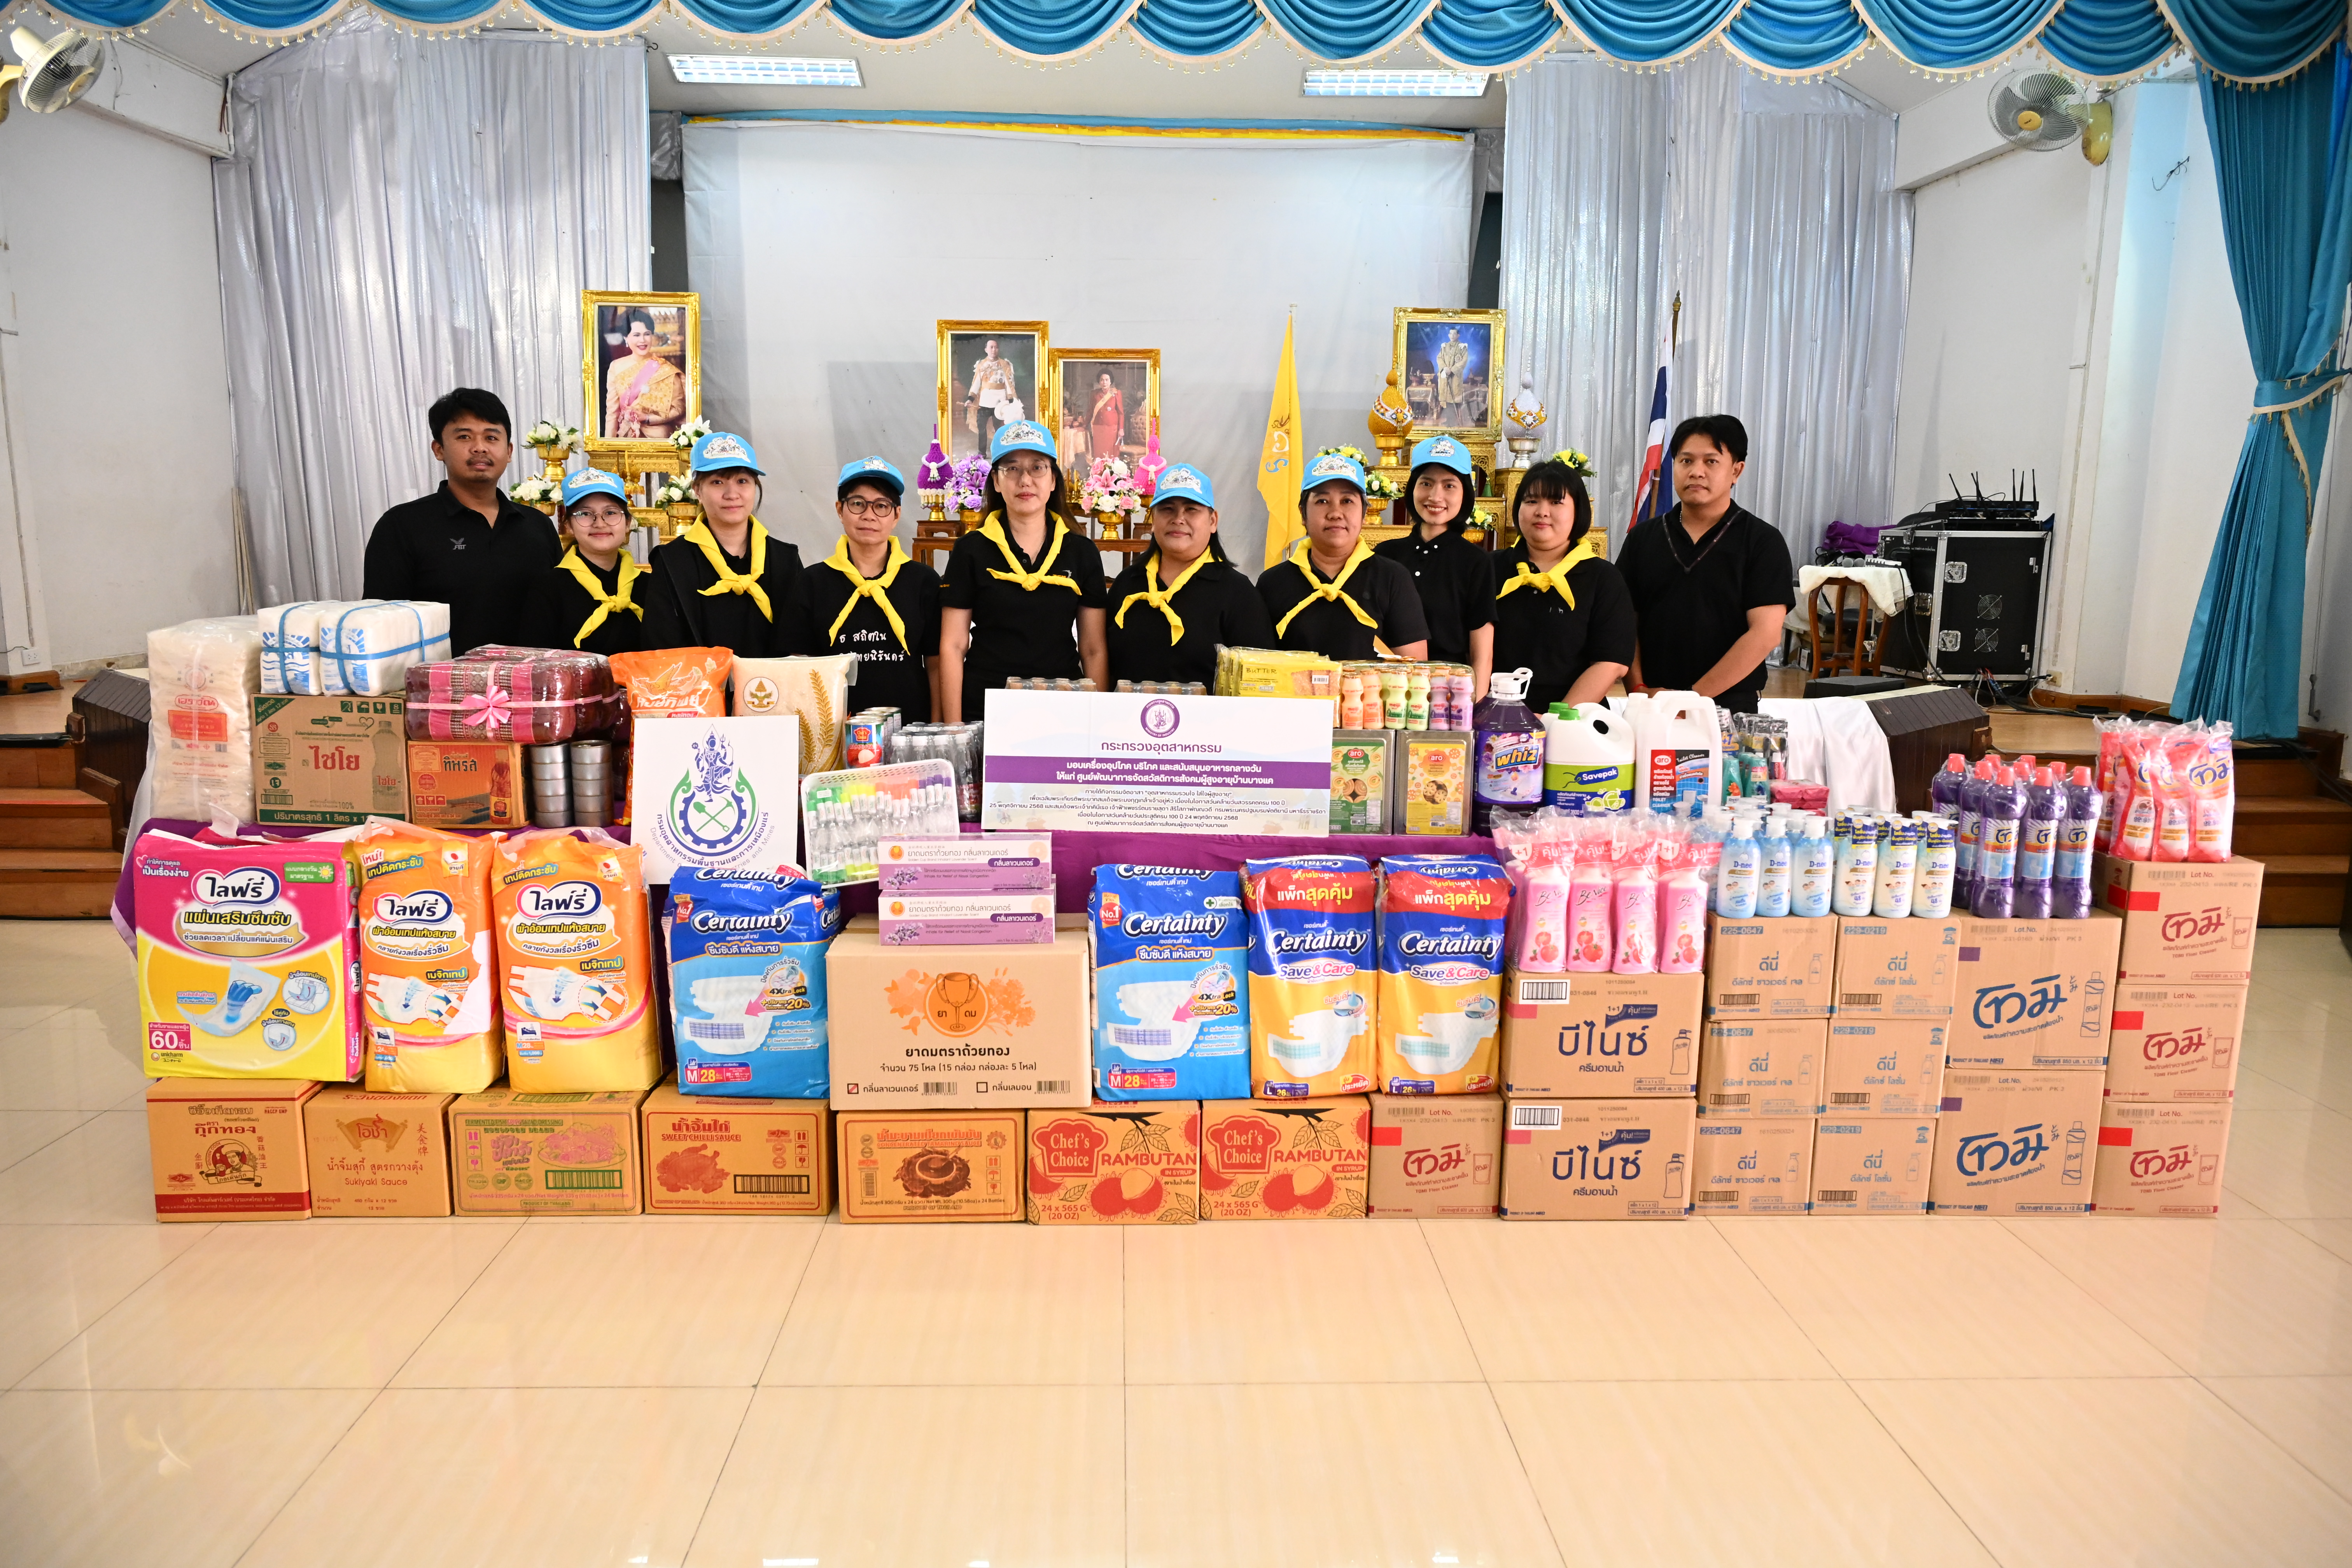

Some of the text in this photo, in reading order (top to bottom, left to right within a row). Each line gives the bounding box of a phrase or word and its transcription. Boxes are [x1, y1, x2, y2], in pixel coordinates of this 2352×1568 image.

[839, 630, 886, 643] ธ สถิตใน
[1101, 742, 1222, 755] กระทรวงอุตสาหกรรม
[309, 746, 360, 770] ไชโย
[443, 755, 477, 772] ทิพรส
[1497, 747, 1537, 766] whiz
[1676, 755, 1689, 763] Toilet
[1067, 758, 1262, 774] มอบเครื่องอุปโภค บริโภค และสนับสนุนอาหารกลางวัน
[376, 775, 396, 786] ไชโย
[1056, 771, 1274, 786] ให้แก่ ศูนย์พัฒนาการจัดสวัสดิการสังคมผู้สูงอายุบ้านบางแค
[1582, 769, 1617, 781] Savepak
[338, 801, 354, 810] 100%
[1175, 798, 1269, 806] เนื่องในโอกาสวันคล้ายวันสวรรคตครบ
[275, 812, 350, 823] ปริมาตรสุทธิ ลิตร
[1078, 811, 1167, 820] เนื่องในโอกาสวันคล้ายวันประสูติครบ
[650, 825, 775, 863] Department and Mines
[657, 812, 768, 867] กรมอุตสาหกรรมพื้นฐานและการเหมืองแร่
[964, 847, 1008, 857] กลิ่นลาเวนเดอร์
[147, 858, 180, 866] ทำให้การดูแล
[368, 857, 423, 878] เทปติดกระชับ
[142, 867, 189, 878] เป็นเรื่องง่าย
[205, 876, 266, 899] ไลฟ์รี่
[1277, 886, 1353, 908] แพ็กสุดคุ้ม
[1414, 890, 1491, 912] แพ็กสุดคุ้ม
[388, 899, 438, 916] ไลฟ์รี่
[677, 904, 693, 915] No.1
[184, 910, 291, 926] แผ่นเสริมซึมซับ
[693, 912, 793, 933] Certainty
[1125, 912, 1226, 936] Certainty
[2161, 906, 2225, 942] โทมิ
[183, 932, 294, 945] ช่วยลดเวลา เปลี่ยนแค่แผ่นเสริม
[372, 926, 457, 939] ผ้าอ้อมเทปแห้งสบาย
[1269, 929, 1370, 954] Certainty
[1400, 932, 1503, 961] Certainty
[377, 944, 449, 957] คลายกังวลเรื่องรั่วซึม
[709, 943, 779, 955] ซึมซับดี แห้งสบาย
[1759, 951, 1779, 971] ดีนี่
[427, 968, 466, 980] เมจิกเทป
[760, 957, 800, 984] ป้องกันการรั่วซึม
[1278, 961, 1356, 977] Save&Care
[1732, 976, 1787, 986] ดีลักซ์ ชาวเวอร์
[1899, 976, 1917, 985] โลชั่น
[769, 987, 792, 995] 4Xtra
[787, 998, 810, 1010] 20%
[1973, 974, 2068, 1029] โทมิ
[937, 1010, 976, 1018] ยา ดม
[152, 1032, 178, 1049] 60
[1558, 1020, 1649, 1056] บีไนซ์
[905, 1044, 1011, 1058] ยาดมตราถ้วยทอง
[880, 1064, 906, 1073] จำนวน
[922, 1062, 936, 1072] โหล
[939, 1063, 952, 1073] (15
[955, 1062, 976, 1072] กล่อง
[978, 1062, 1009, 1071] กล่องละ
[1019, 1061, 1038, 1072] โหล)
[1579, 1061, 1624, 1073] ครีมอาบน้ำ
[687, 1071, 698, 1082] M
[700, 1069, 716, 1082] 28
[863, 1081, 1032, 1094] กลิ่นลาเวนเดอร์ กลิ่นเลมอน
[1341, 1079, 1370, 1093] ประหยัด
[188, 1104, 253, 1115] ซีอิ๊วเห็ดหอม
[195, 1123, 256, 1137] กุ๊กทอง
[672, 1117, 730, 1133] น้ำจิ้มไก่
[877, 1129, 982, 1141] น้ำมะขามเปียกเข้มข้น
[1050, 1133, 1090, 1150] Chef's
[1223, 1130, 1263, 1147] Chef's
[1223, 1149, 1262, 1165] Choice
[1274, 1149, 1367, 1163] RAMBUTAN
[1956, 1123, 2050, 1177] โทมิ
[327, 1157, 423, 1175] น้ำจิ้มสุกี้ สูตรกวางตุ้ง
[1050, 1152, 1089, 1168] Choice
[1101, 1153, 1197, 1167] RAMBUTAN
[1403, 1143, 1466, 1178] โทมิ
[345, 1178, 377, 1186] Sukiyaki
[1041, 1205, 1079, 1213] 24 565
[1048, 1213, 1080, 1222] (20 OZ)
